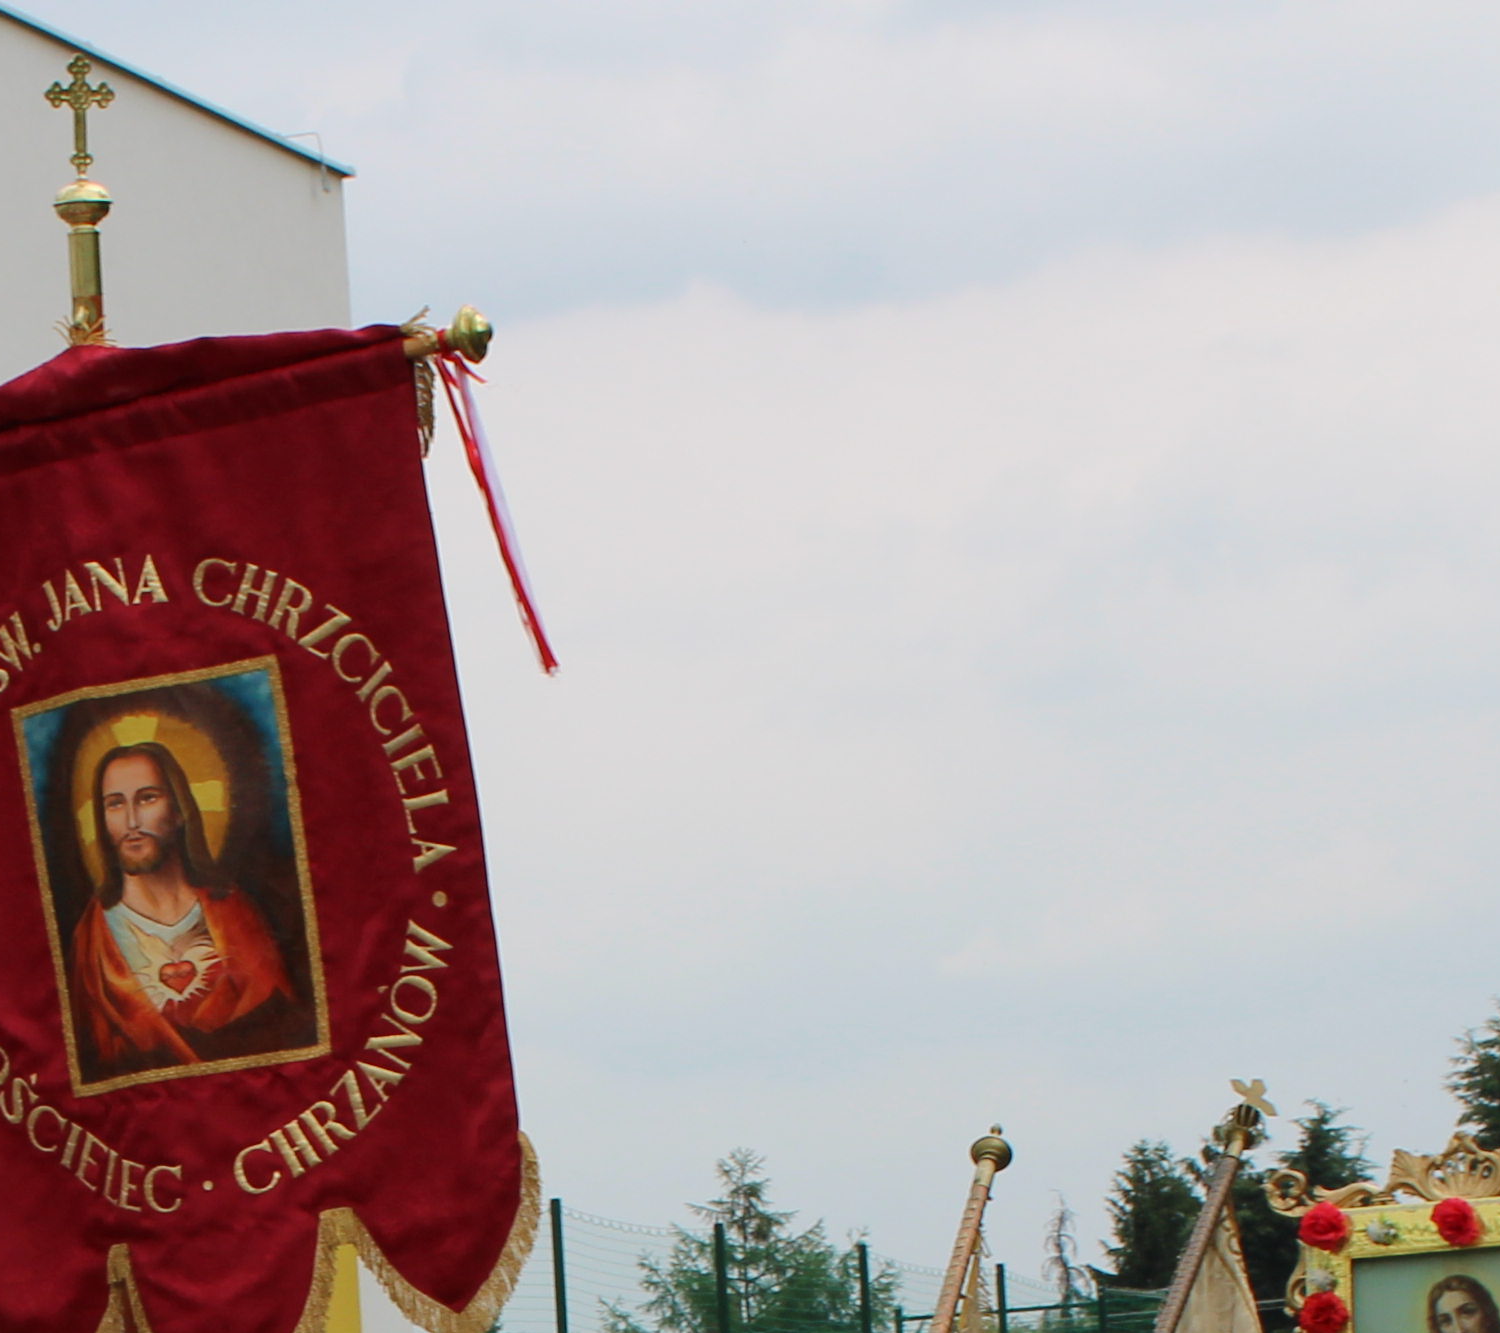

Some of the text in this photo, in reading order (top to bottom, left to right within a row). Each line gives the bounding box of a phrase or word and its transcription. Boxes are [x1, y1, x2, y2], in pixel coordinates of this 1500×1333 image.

[41, 553, 169, 632] JANA
[191, 557, 458, 874] CHRZCICIELA
[232, 918, 455, 1195] CHRZANÓW
